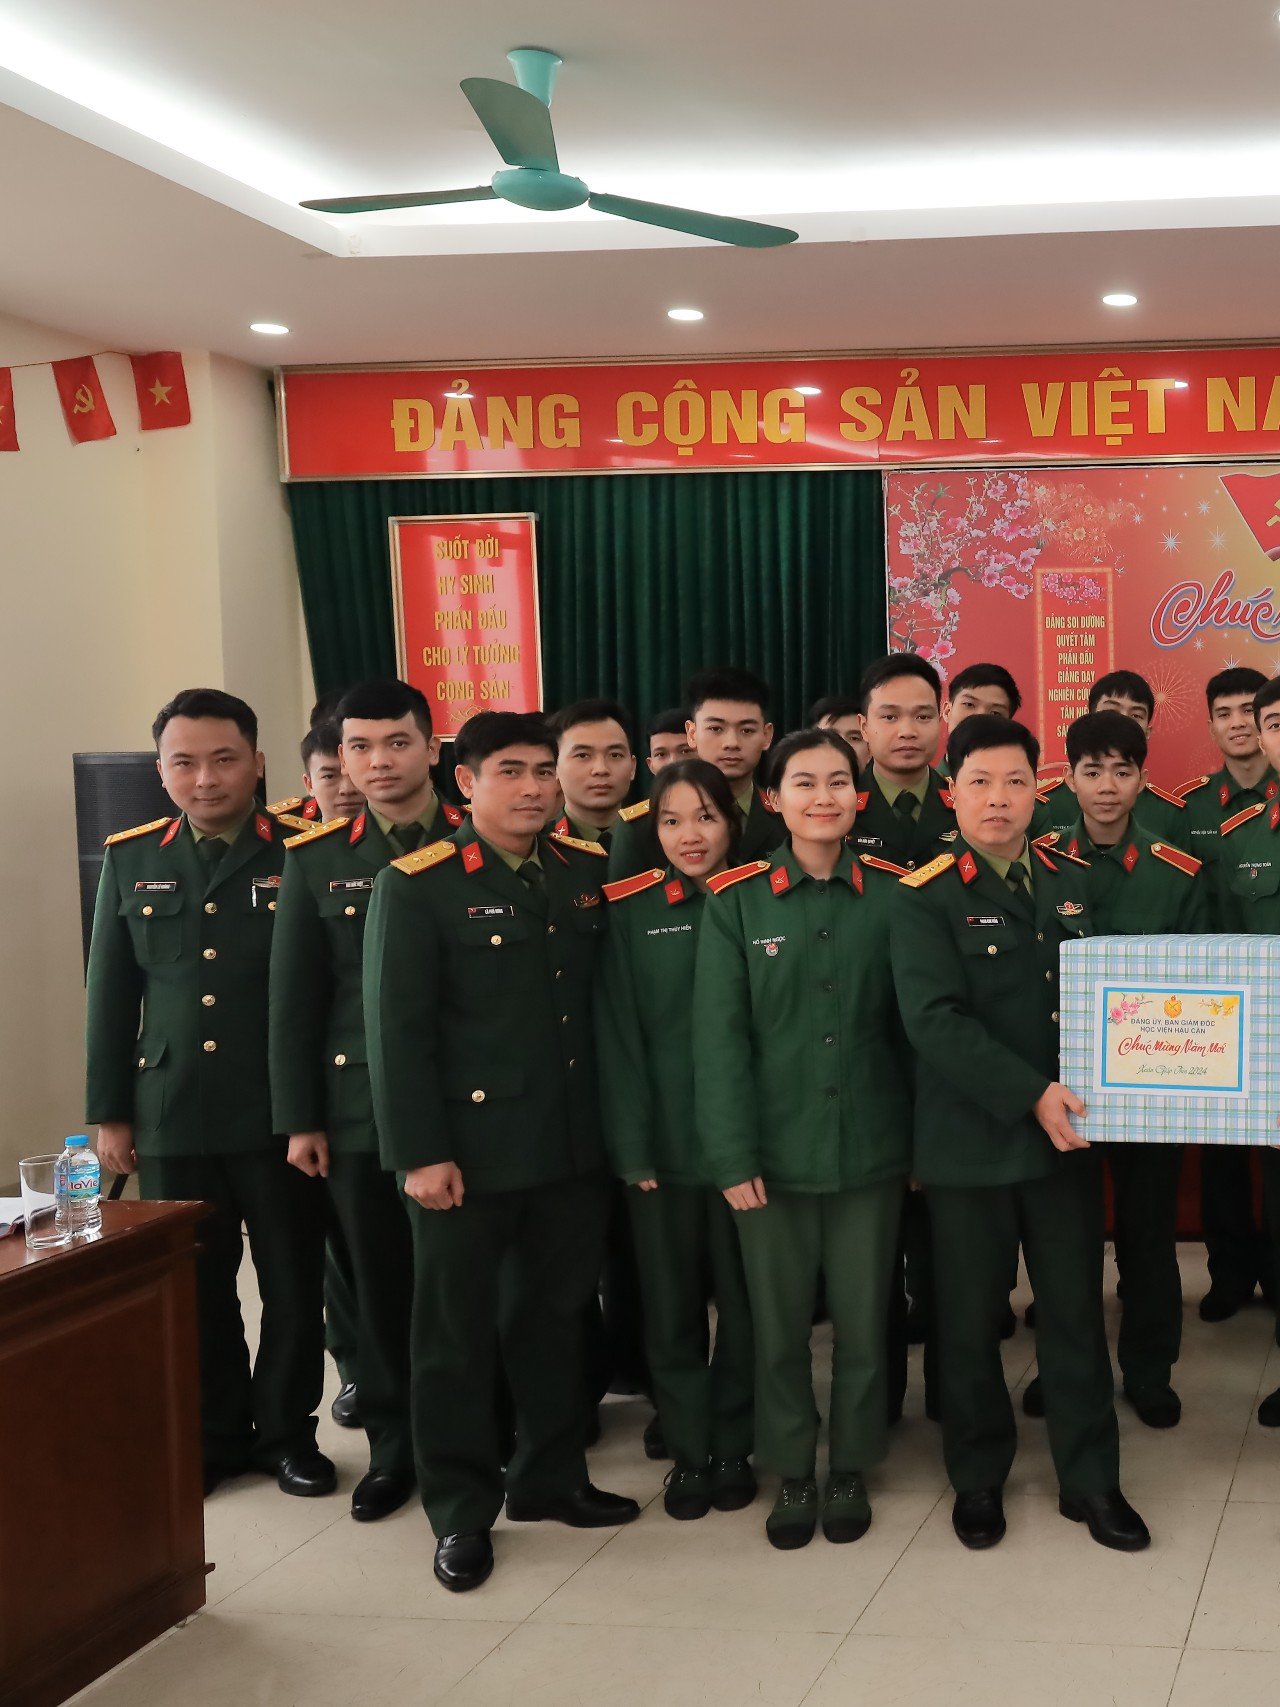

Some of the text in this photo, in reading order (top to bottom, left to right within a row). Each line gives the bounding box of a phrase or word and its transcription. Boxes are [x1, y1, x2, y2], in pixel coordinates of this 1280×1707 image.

[391, 378, 581, 452] ĐẢNG
[618, 380, 806, 456] CỘNG
[840, 367, 986, 442] SẢN
[1021, 367, 1175, 446] VIỆT
[435, 533, 499, 560] SUỐT ĐỜI
[438, 574, 494, 596] HY SINH
[1067, 616, 1079, 629] SOI
[422, 646, 450, 667] CHO
[456, 641, 469, 666] LÝ
[479, 673, 510, 700] SẢN
